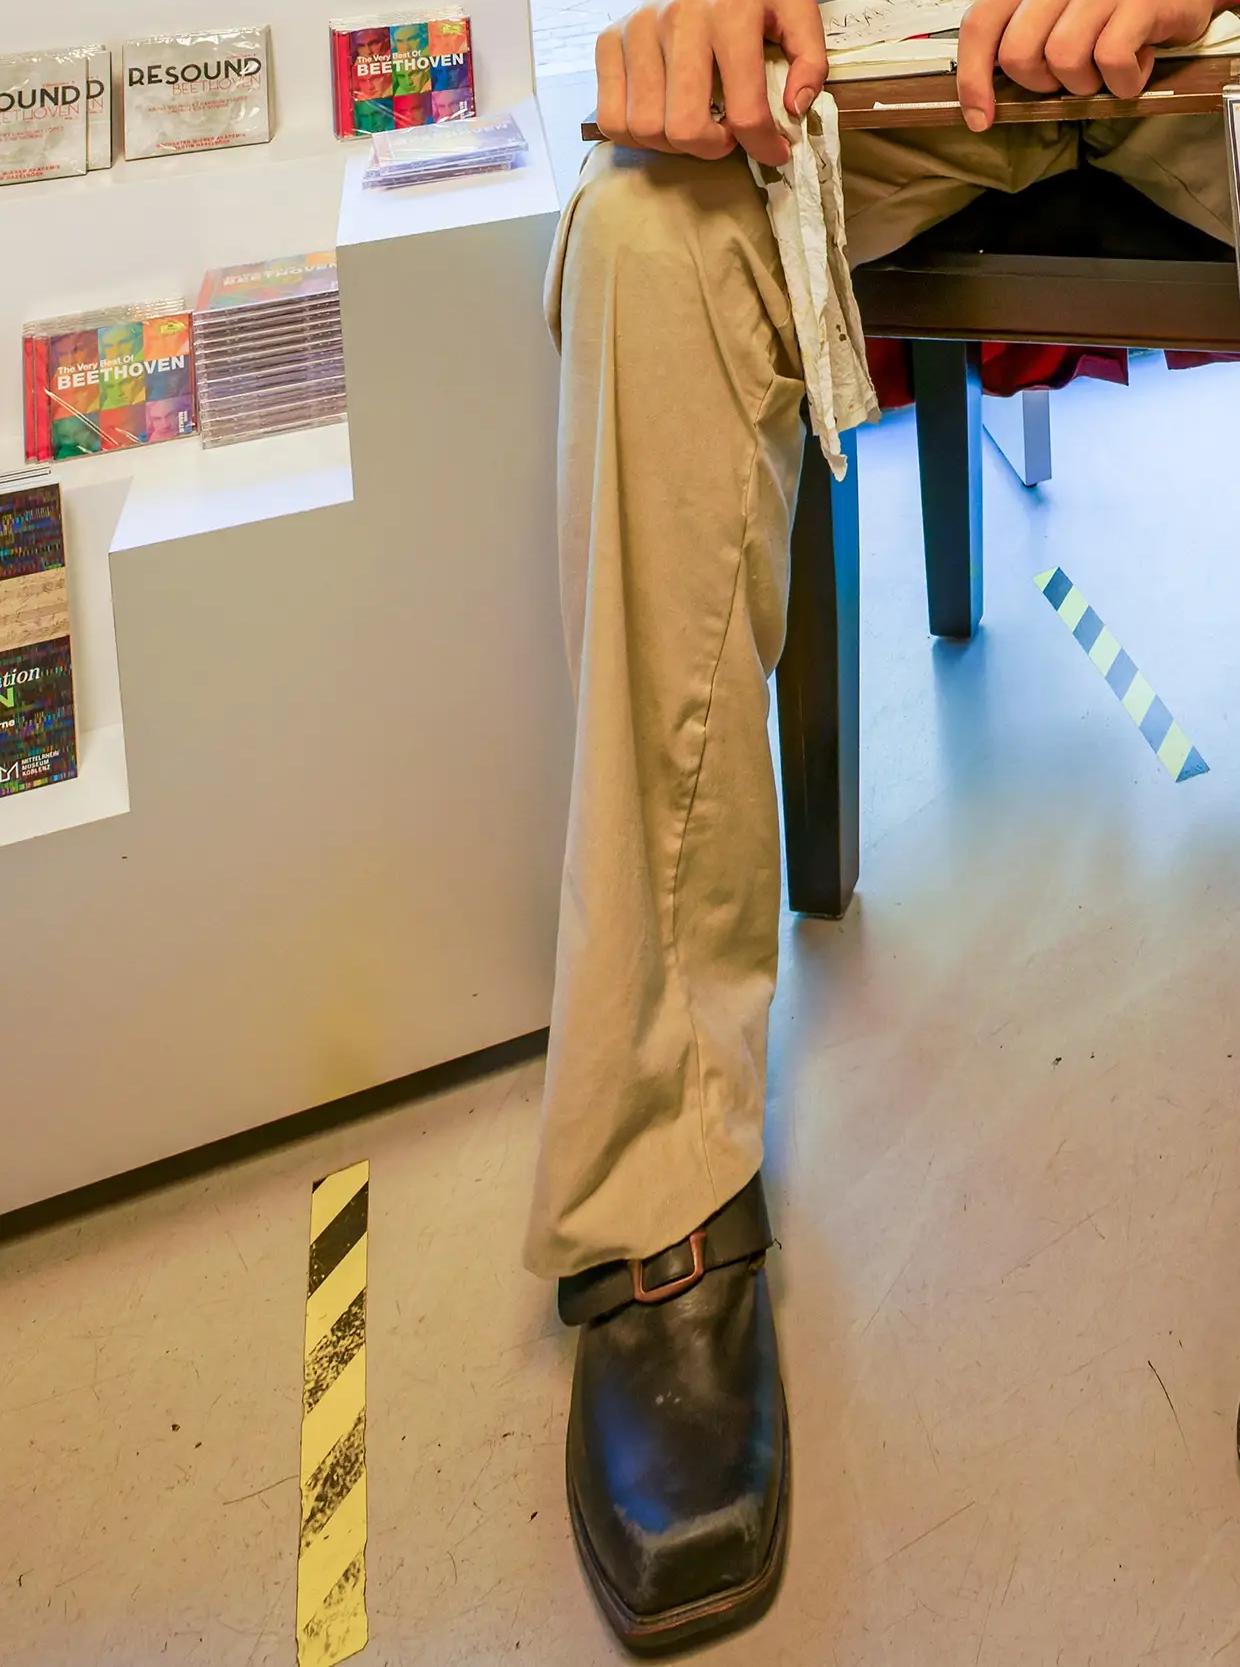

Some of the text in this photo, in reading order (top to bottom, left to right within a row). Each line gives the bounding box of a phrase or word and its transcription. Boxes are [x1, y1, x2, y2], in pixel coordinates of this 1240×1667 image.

[357, 53, 464, 77] BEETHOVEN
[358, 50, 422, 65] The Very Best Of
[128, 57, 262, 87] RESOUND
[57, 354, 185, 391] BEETHOVEN
[58, 354, 134, 375] The Very Best Of
[0, 666, 40, 687] tion
[22, 759, 50, 771] MUSEUM
[22, 765, 51, 776] KOBLENZ
